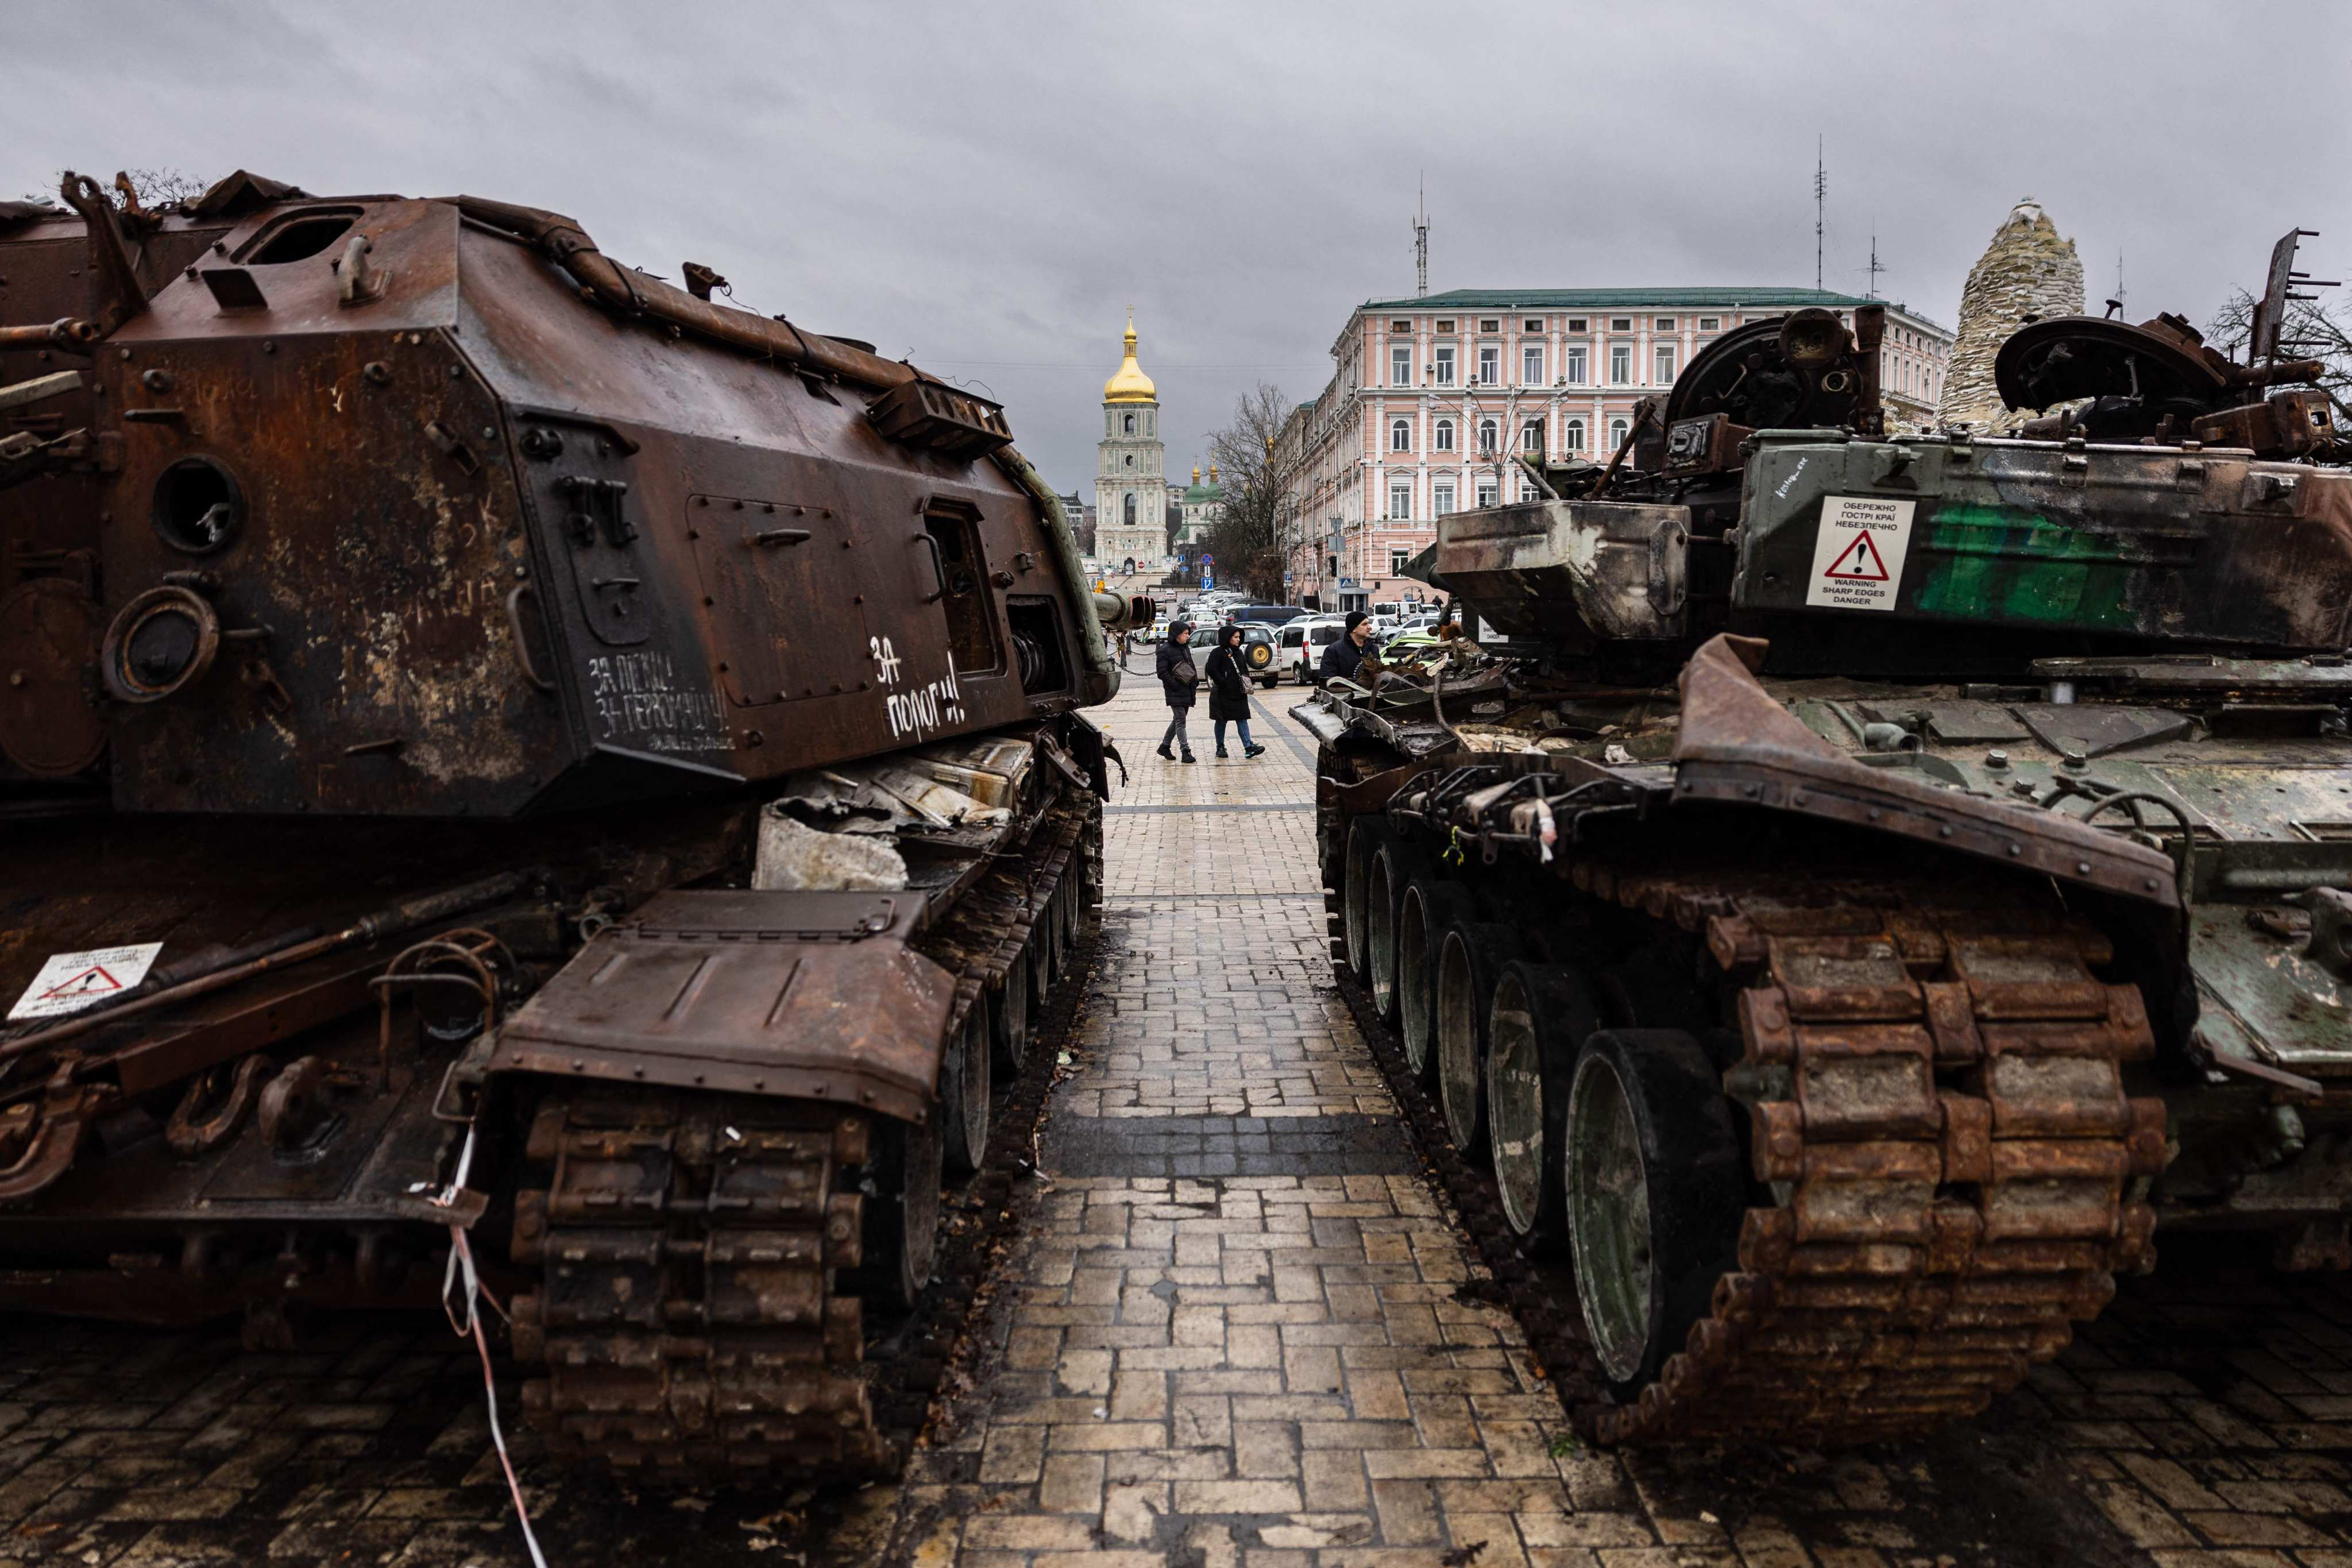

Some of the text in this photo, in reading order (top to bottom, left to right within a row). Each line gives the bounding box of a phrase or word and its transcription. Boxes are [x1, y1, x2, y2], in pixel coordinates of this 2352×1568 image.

[1844, 502, 1897, 512] ОБЕРЕЖНО
[1841, 511, 1897, 521] ГОСТРІ КРАЇ
[1835, 520, 1898, 531] НЕБЕЗПЕЧНО
[1835, 578, 1876, 588] WARNING
[1822, 586, 1885, 597] SHARP EDGES
[1833, 596, 1871, 605] DANGER
[870, 636, 901, 692] ЗА
[589, 656, 617, 697] ЗА
